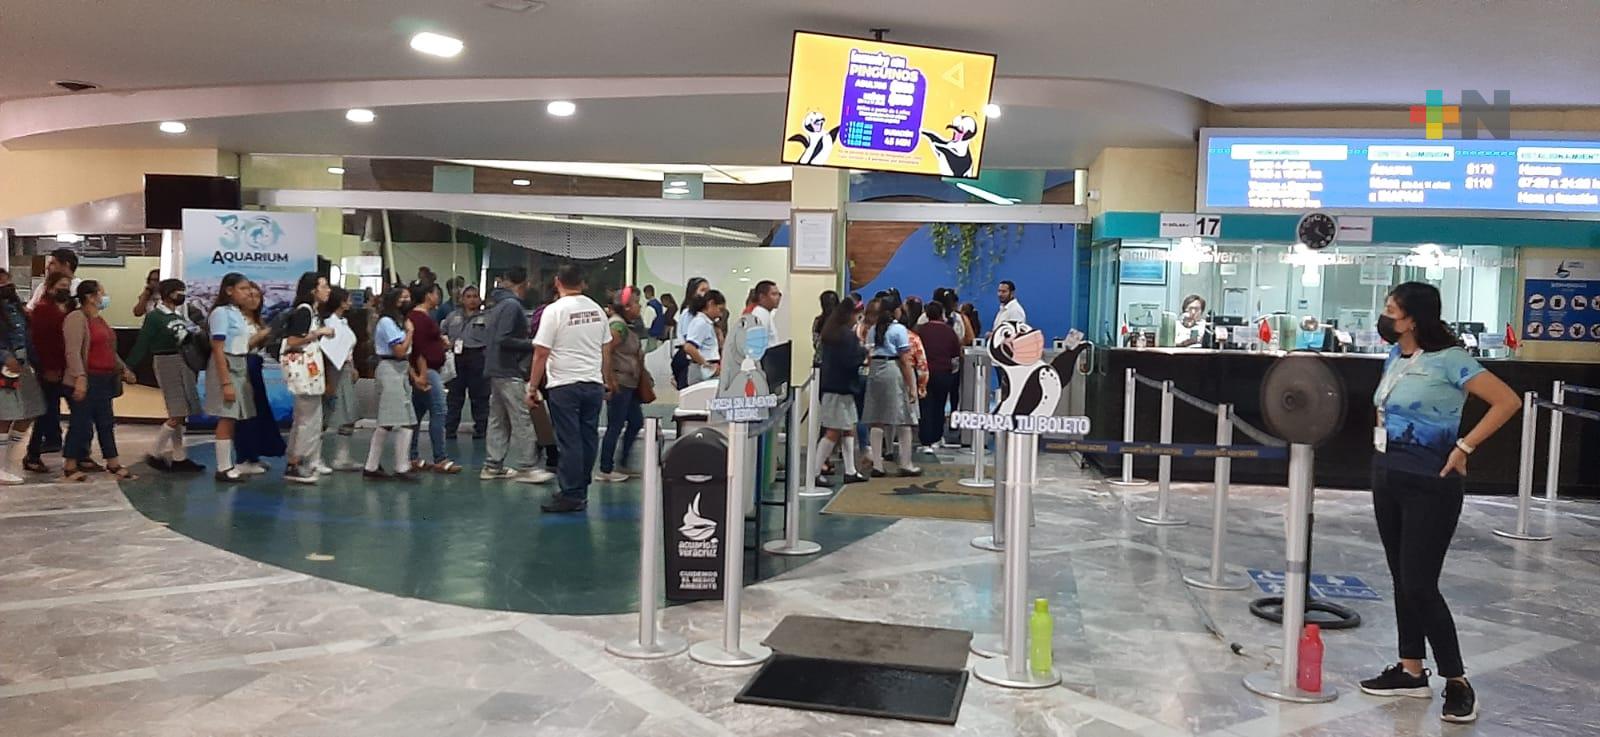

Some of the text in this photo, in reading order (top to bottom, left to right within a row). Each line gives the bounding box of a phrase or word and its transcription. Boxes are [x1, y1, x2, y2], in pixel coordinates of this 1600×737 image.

[1197, 217, 1220, 235] 17
[211, 250, 289, 265] AQUARIUM
[950, 411, 1090, 434] PREPARA TU BOLETO
